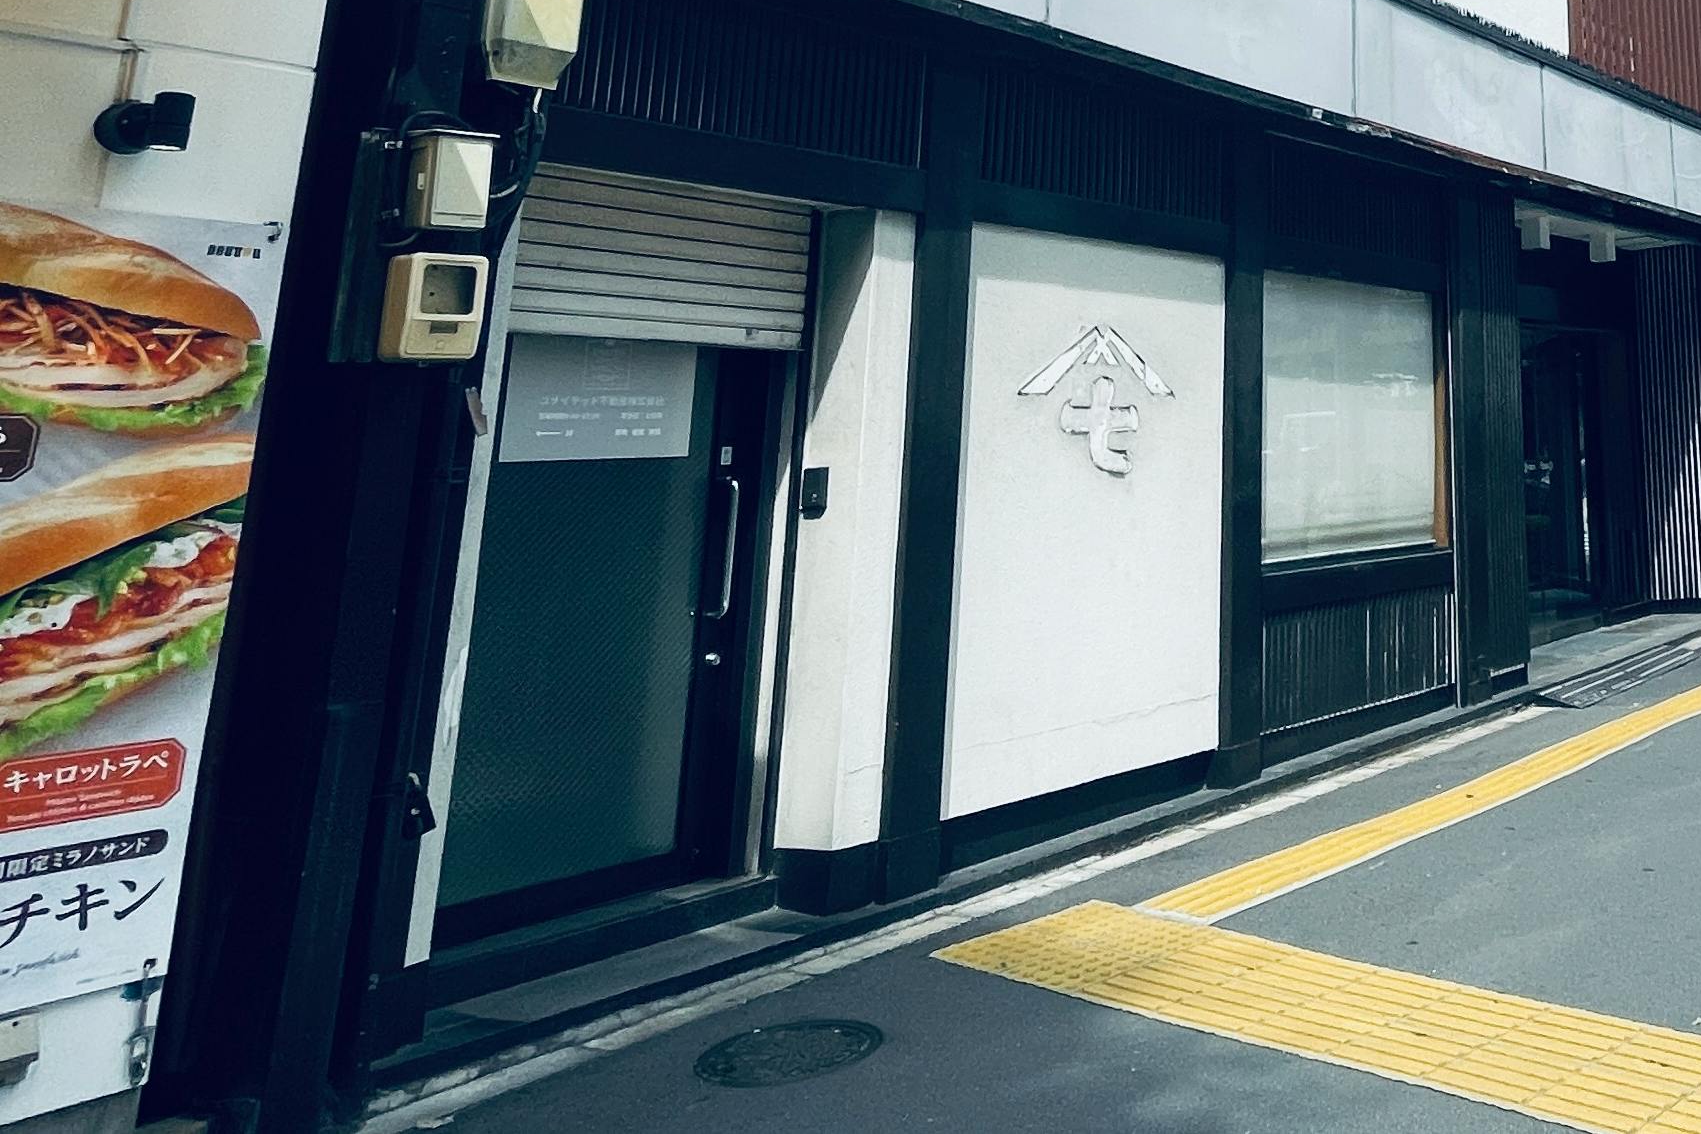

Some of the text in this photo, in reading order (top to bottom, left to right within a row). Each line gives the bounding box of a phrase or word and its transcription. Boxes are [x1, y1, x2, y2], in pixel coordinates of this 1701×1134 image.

[3, 750, 169, 793] キャロットラペ
